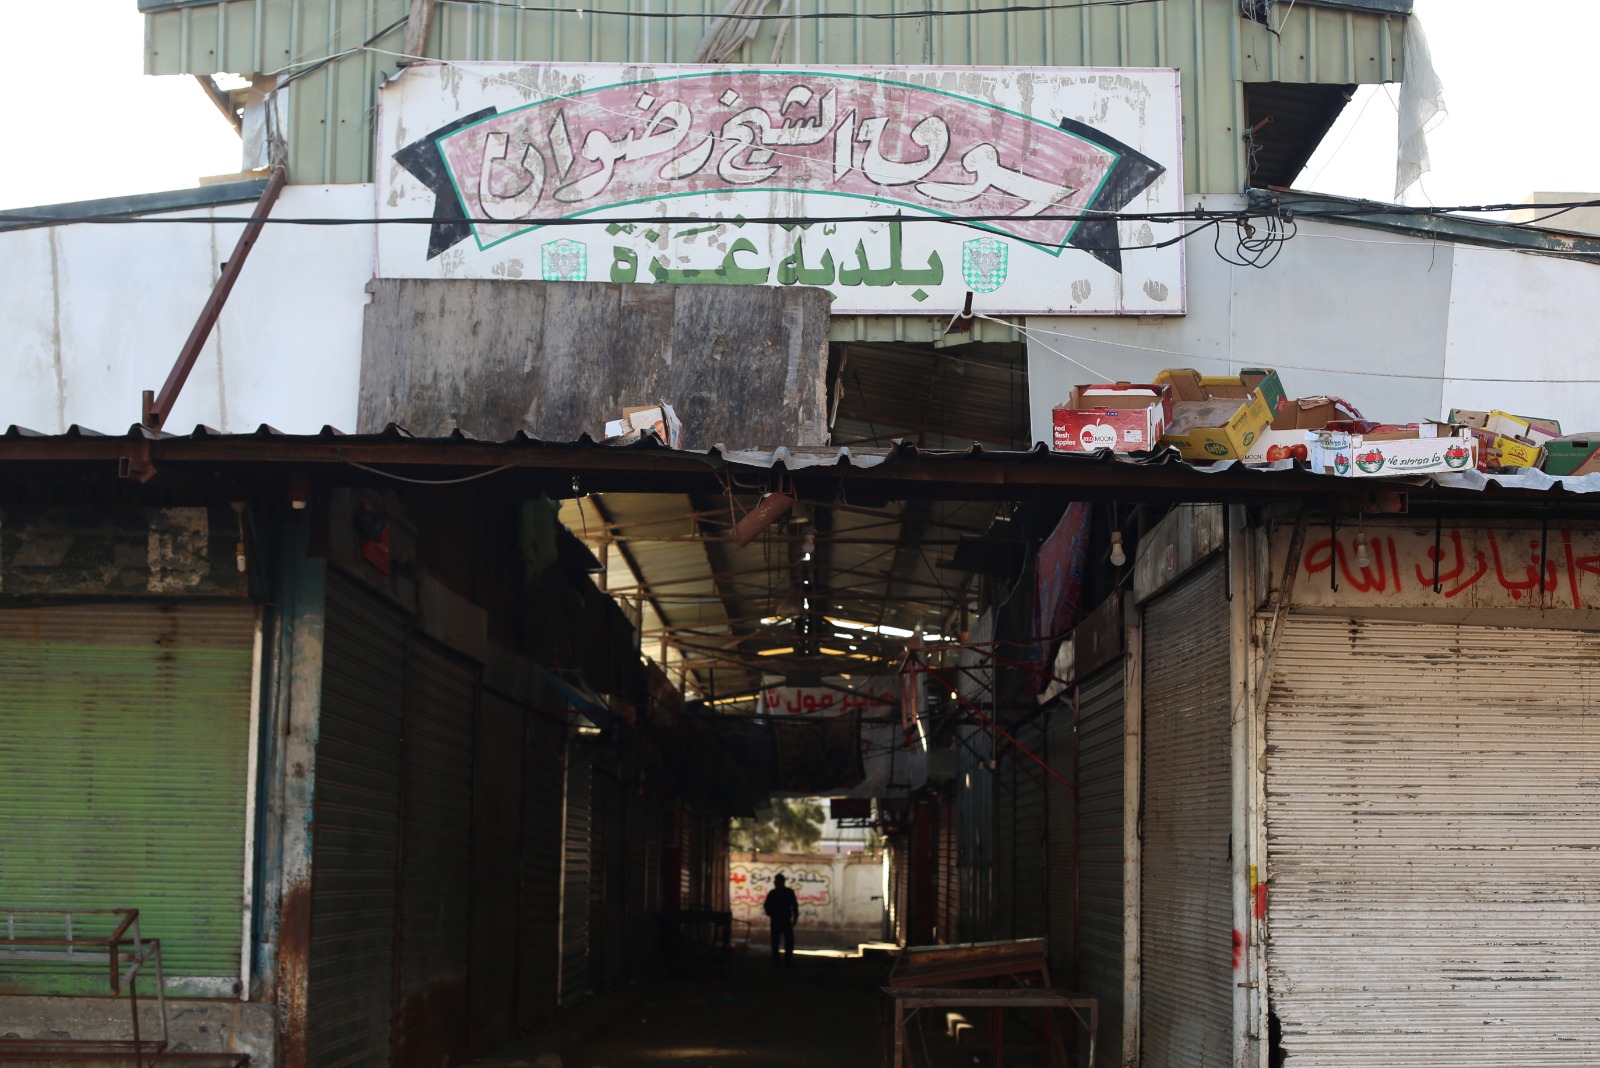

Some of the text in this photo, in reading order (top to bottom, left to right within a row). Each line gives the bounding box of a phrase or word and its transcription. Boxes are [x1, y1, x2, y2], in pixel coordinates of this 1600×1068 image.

[477, 90, 716, 222] رضوان
[716, 83, 857, 185] الشيخ
[1054, 439, 1076, 448] apples
[1303, 536, 1402, 593] الله
